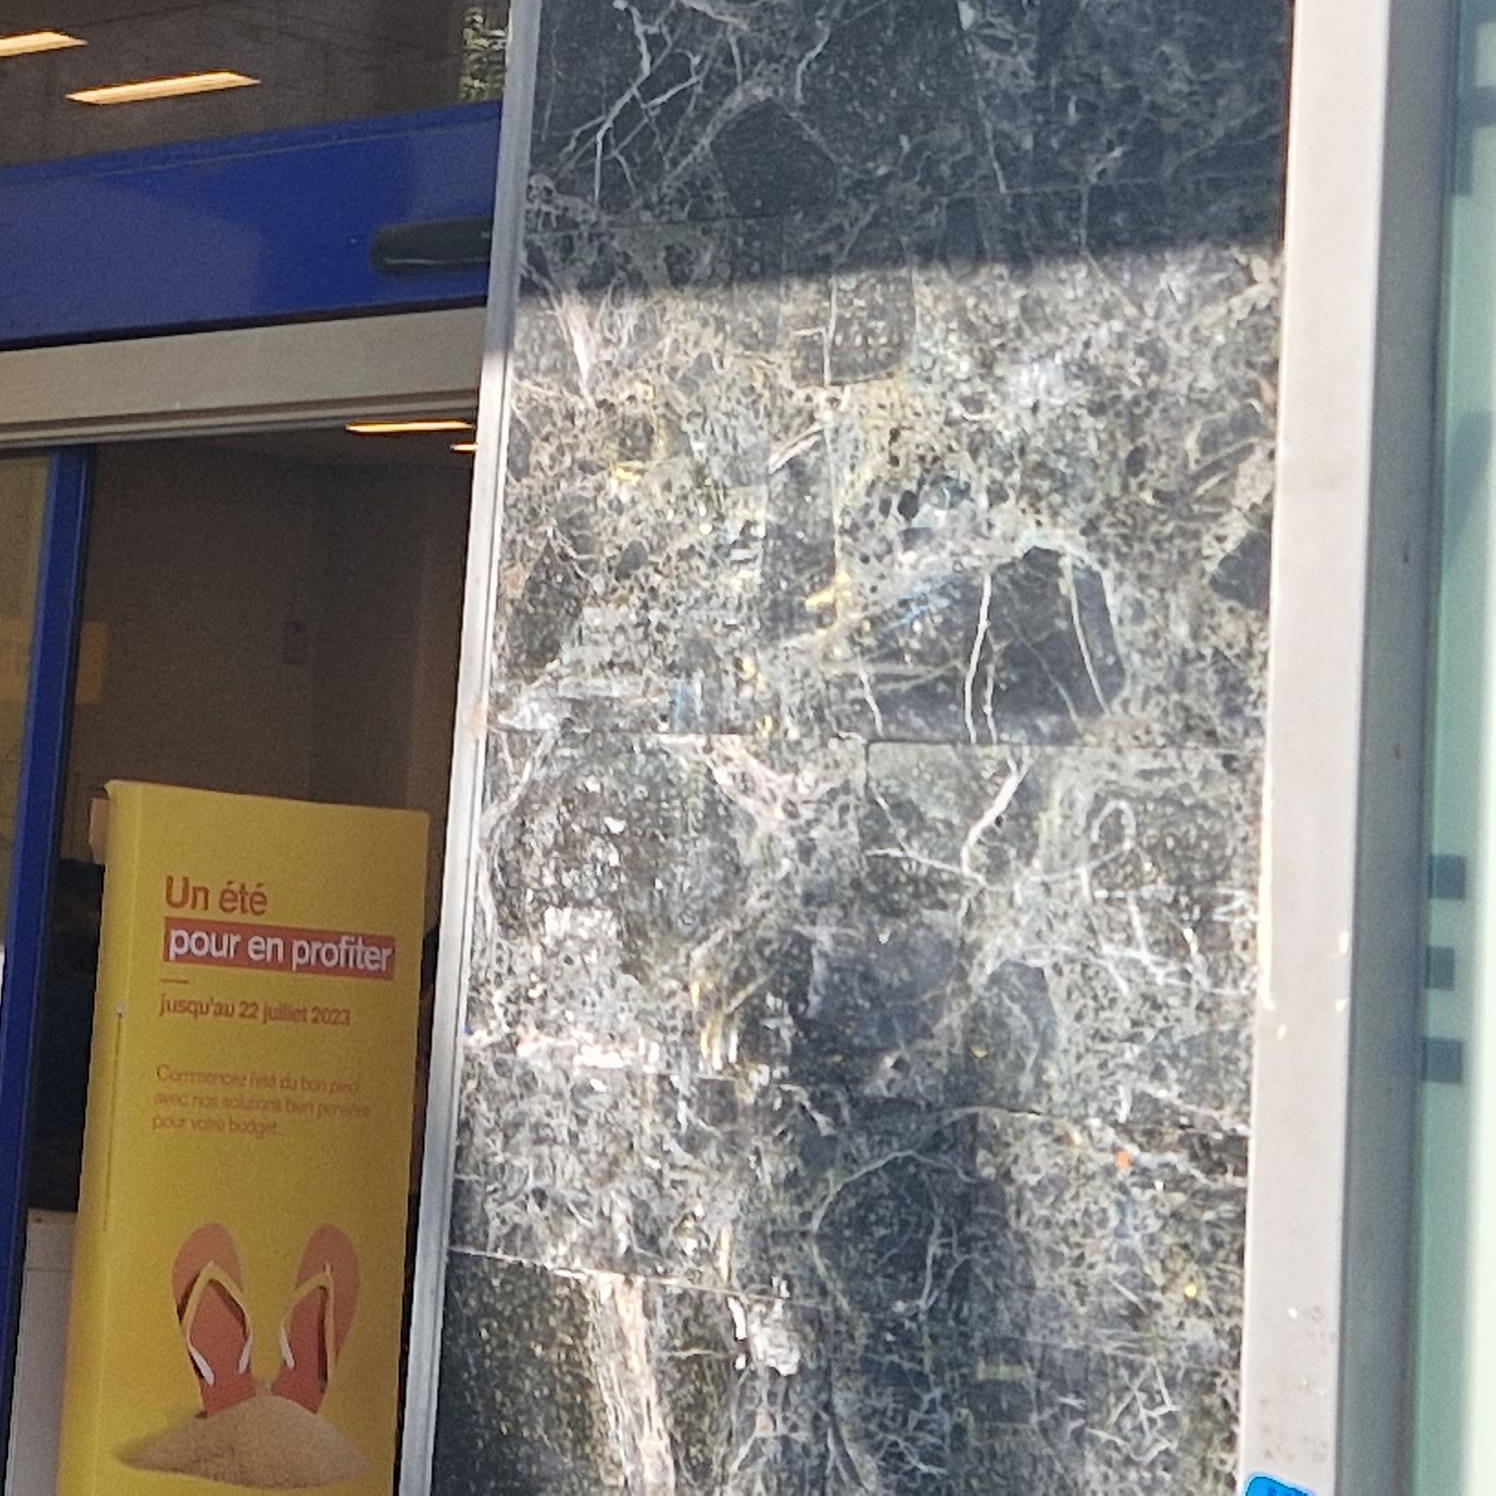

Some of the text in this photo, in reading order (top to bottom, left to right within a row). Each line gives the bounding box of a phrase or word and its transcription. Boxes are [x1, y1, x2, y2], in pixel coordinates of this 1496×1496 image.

[165, 875, 268, 916] Un été
[169, 929, 392, 972] pour en profiter
[159, 993, 350, 1026] jusqu'au 22 juillet 2023
